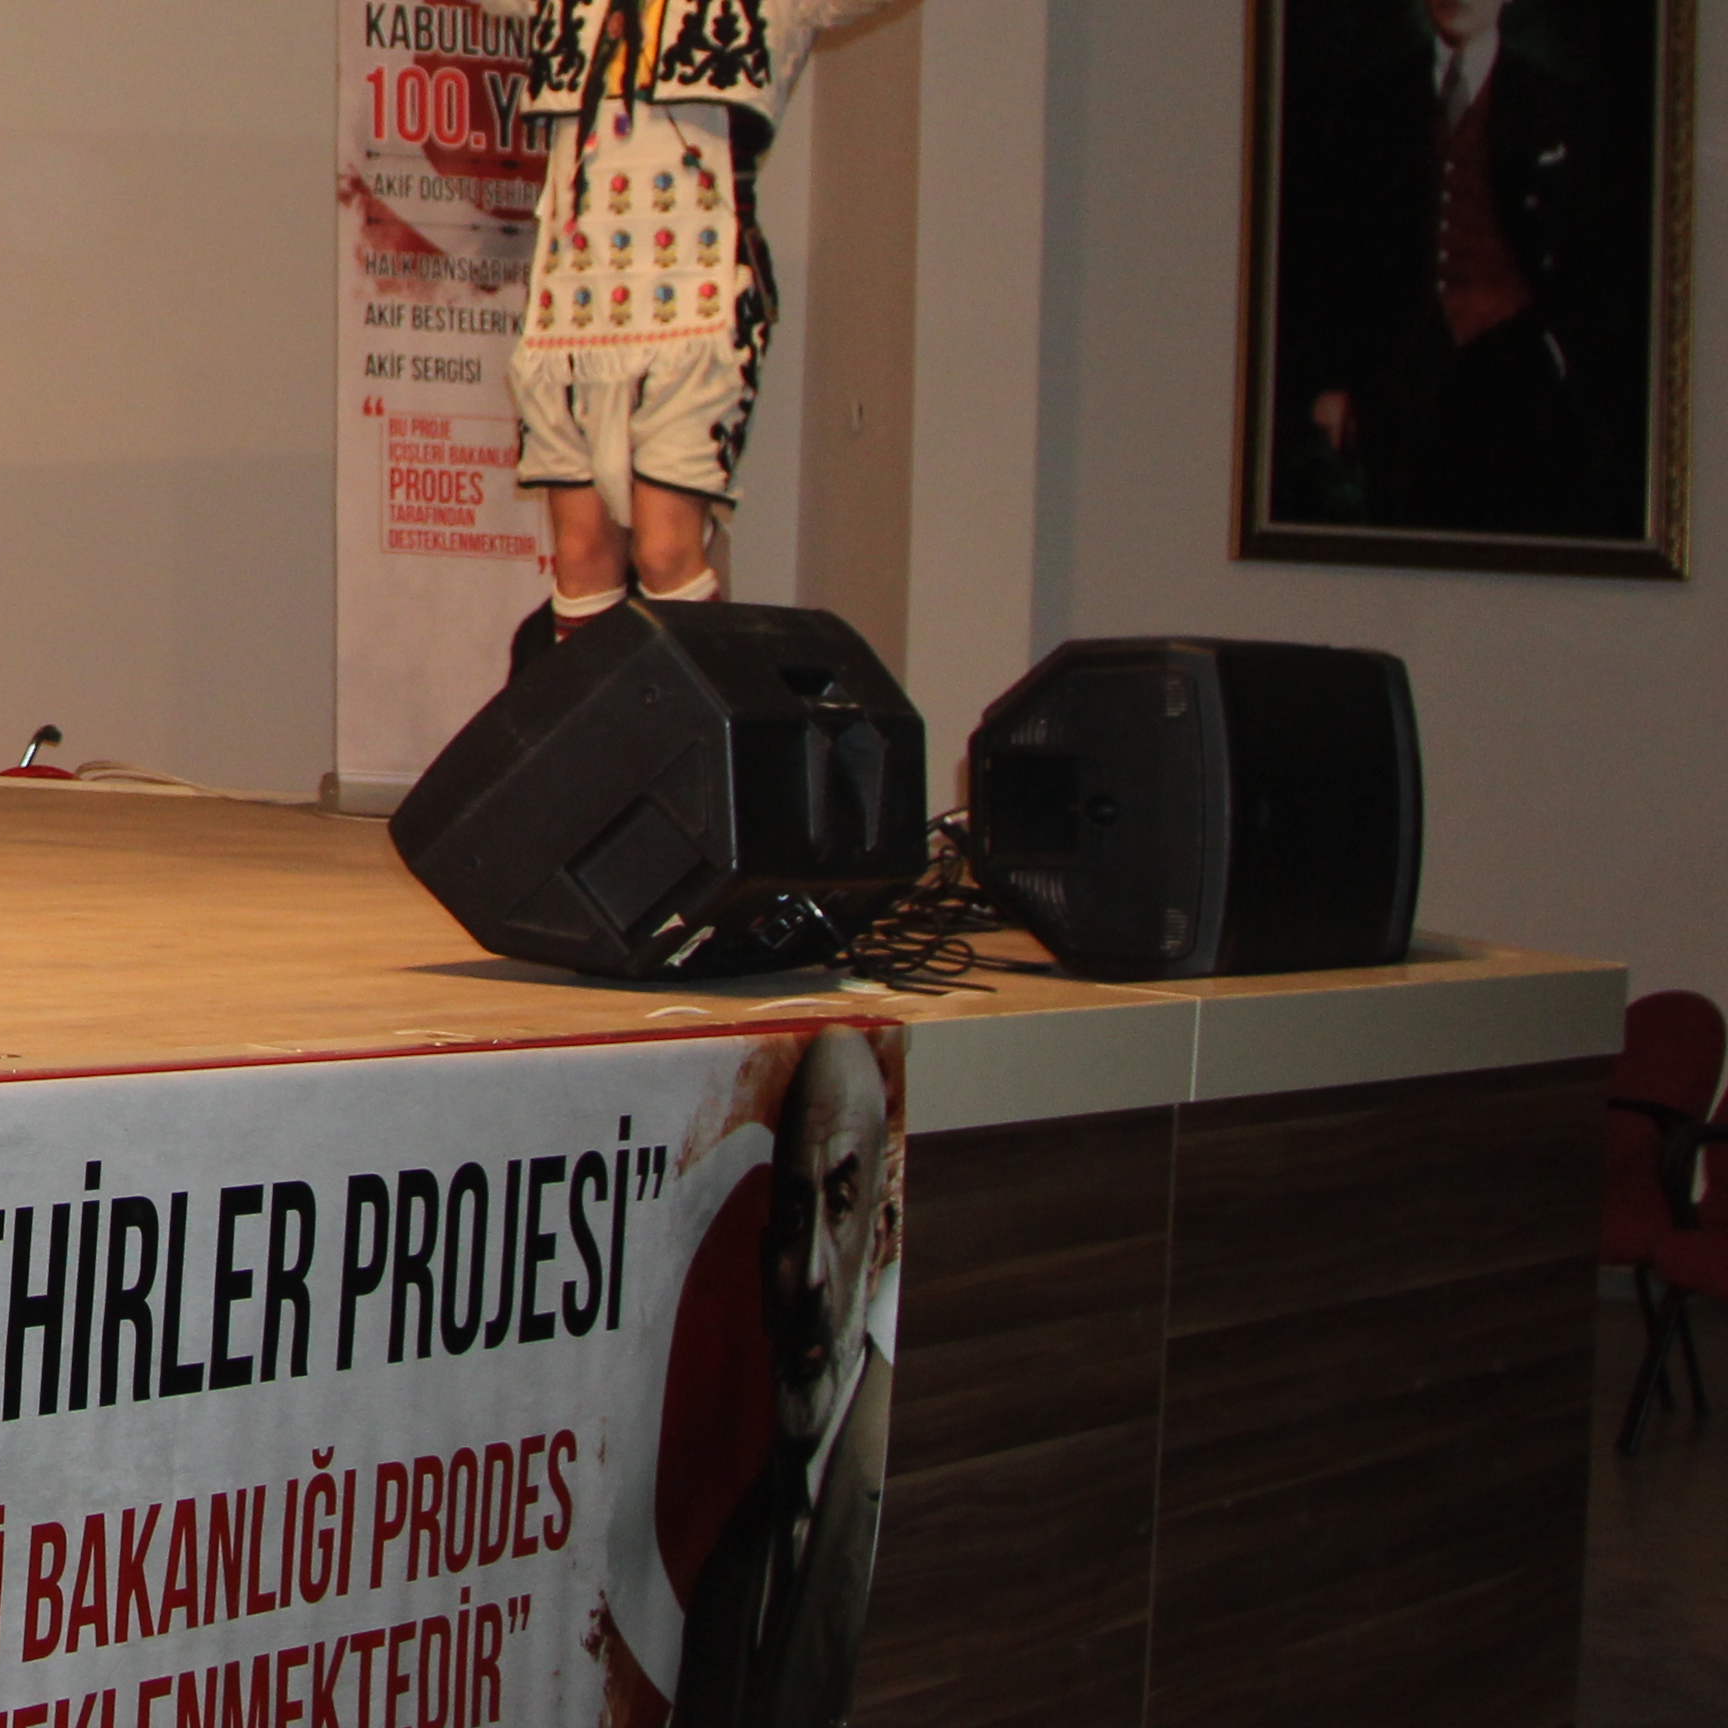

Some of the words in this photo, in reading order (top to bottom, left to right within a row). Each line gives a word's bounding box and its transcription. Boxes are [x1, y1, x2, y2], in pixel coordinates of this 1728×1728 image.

[366, 66, 483, 147] 100.
[420, 176, 479, 203] DOSTU
[366, 250, 413, 275] HALK
[365, 301, 406, 327] AKİF
[411, 304, 507, 335] BESTELERİ
[365, 352, 406, 379] AKİF
[411, 355, 482, 384] SERGİSİ
[389, 467, 484, 506] PRODES
[337, 1116, 666, 1370] PROJESİ”
[23, 1447, 355, 1661] BAKANLIĞI
[370, 1430, 576, 1589] PRODES
